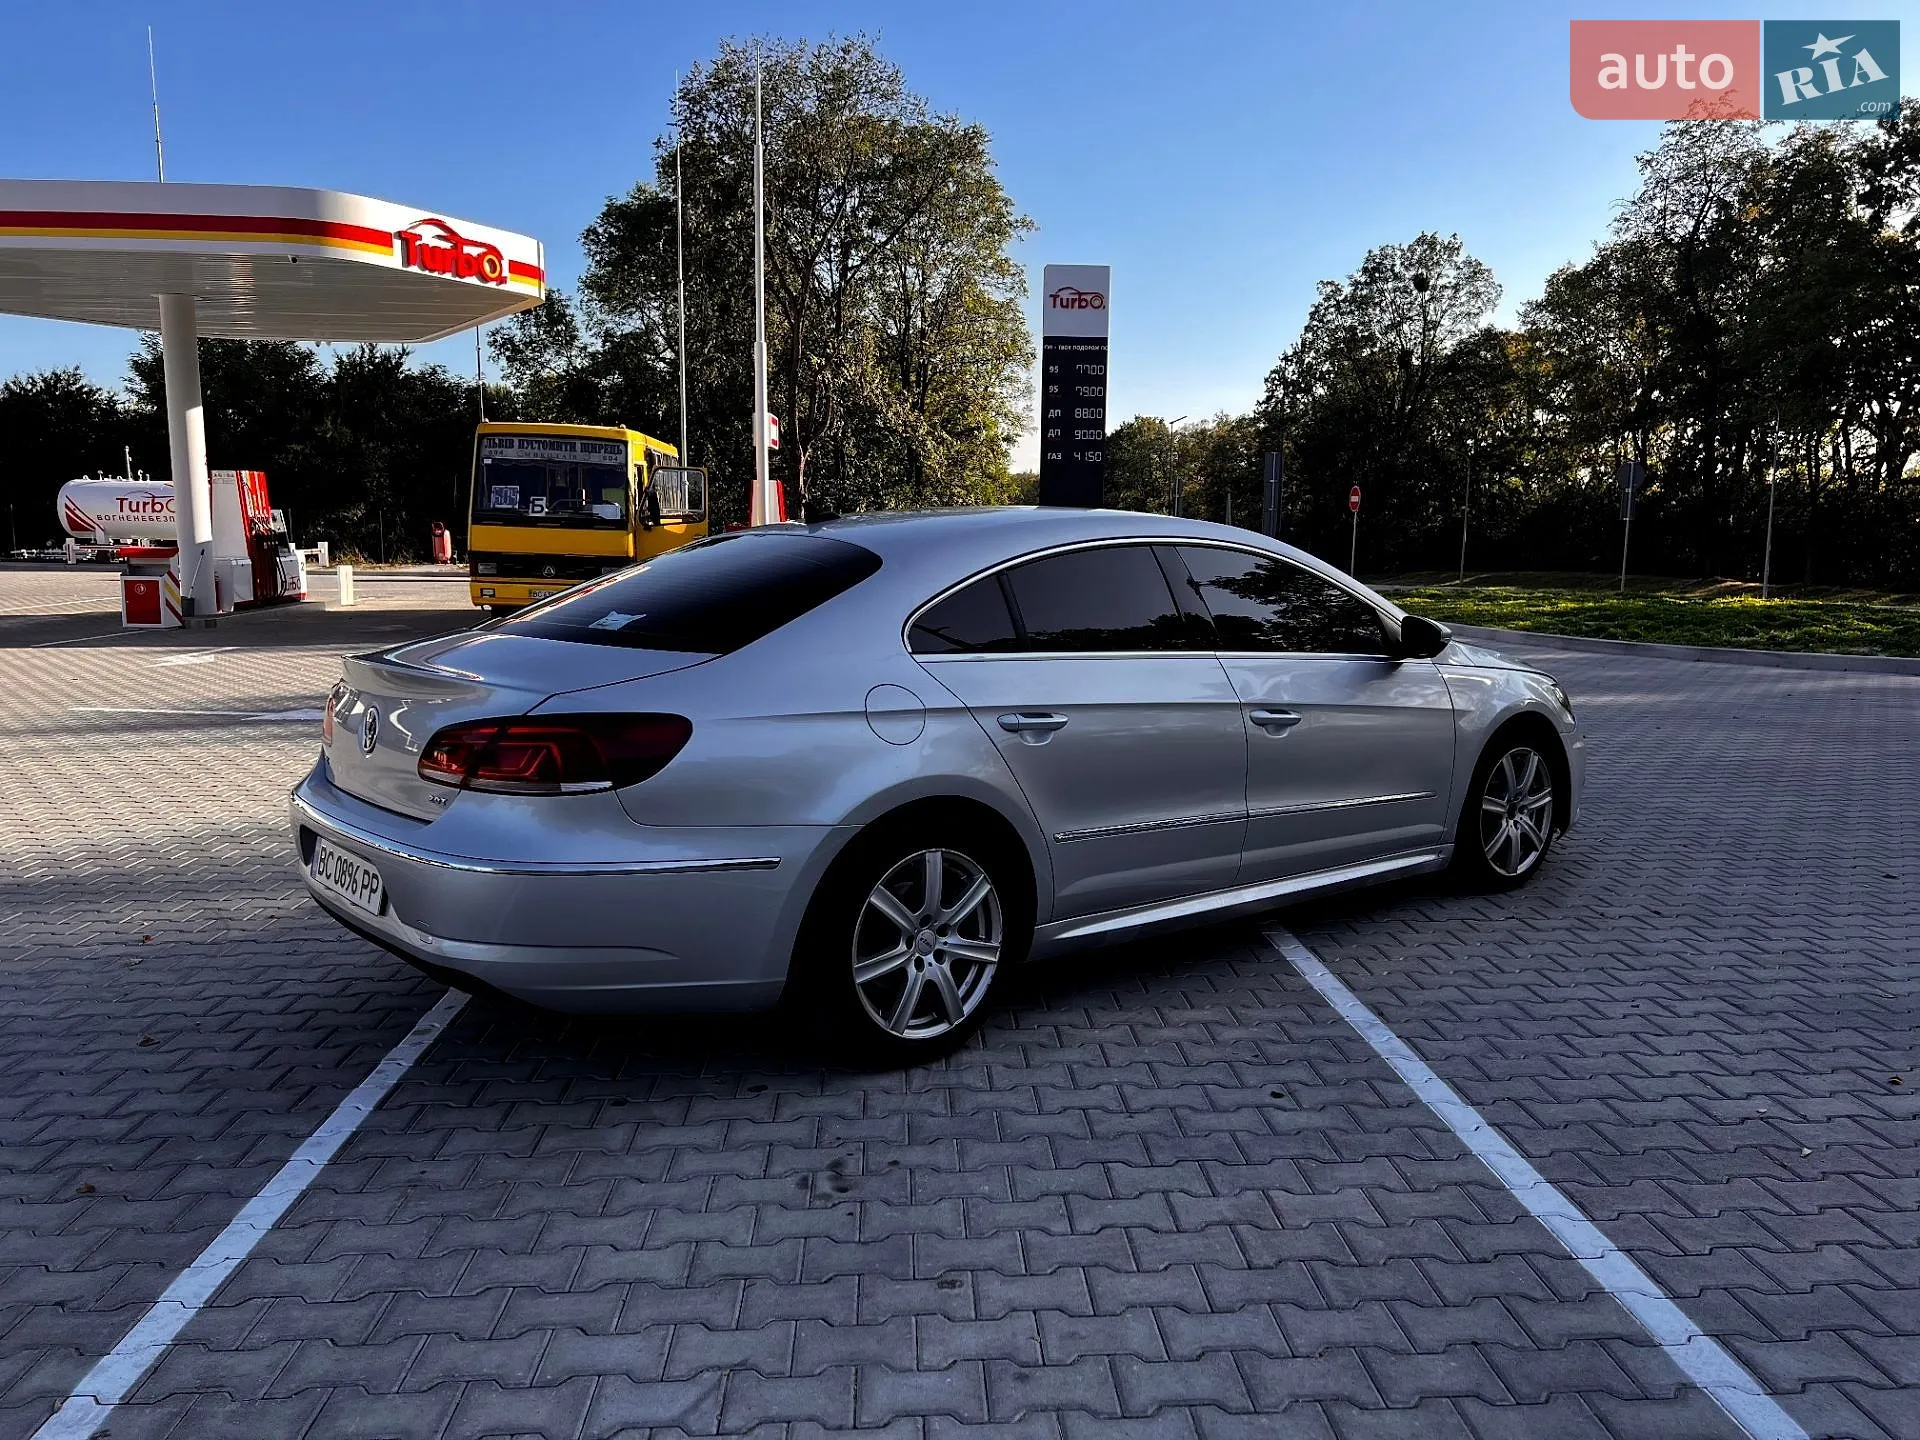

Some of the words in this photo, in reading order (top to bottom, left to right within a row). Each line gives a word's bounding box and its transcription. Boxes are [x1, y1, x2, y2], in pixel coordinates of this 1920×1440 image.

[1049, 365, 1059, 373] 95
[1048, 409, 1061, 419] ДП
[485, 437, 514, 449] ЛЬВІВ
[1047, 452, 1062, 460] ГАЗ
[318, 846, 334, 879] BC
[334, 855, 360, 894] 0896
[360, 869, 380, 904] PP
